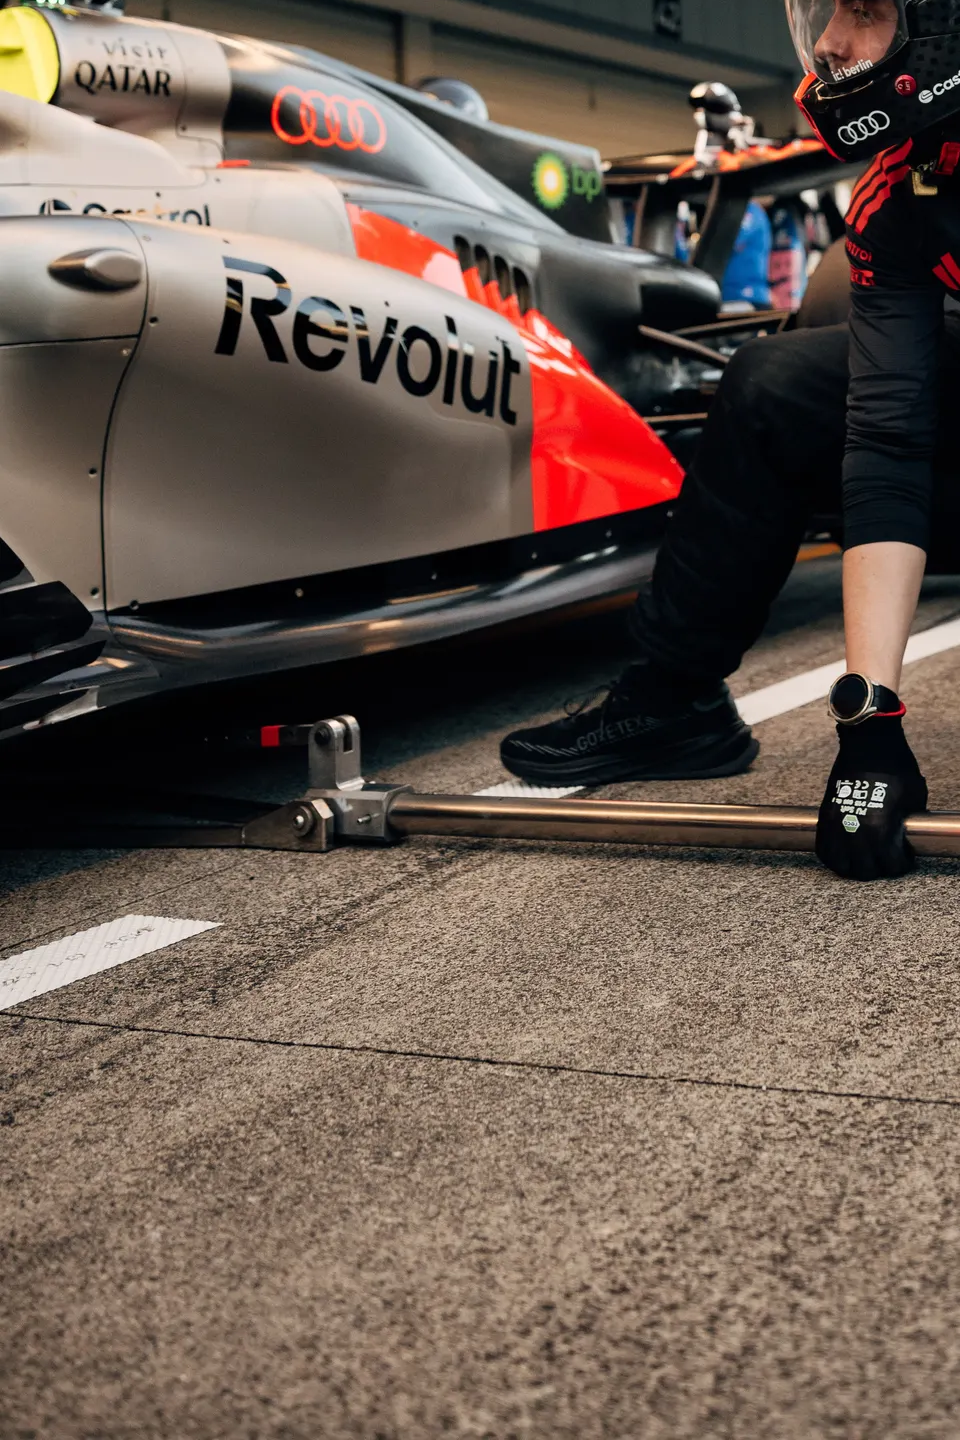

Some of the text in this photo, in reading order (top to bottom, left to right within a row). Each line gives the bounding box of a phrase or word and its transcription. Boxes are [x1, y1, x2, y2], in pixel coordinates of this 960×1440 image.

[75, 60, 171, 97] QATAR
[842, 58, 873, 78] berlin
[572, 164, 602, 202] bp
[214, 256, 521, 425] Revolut
